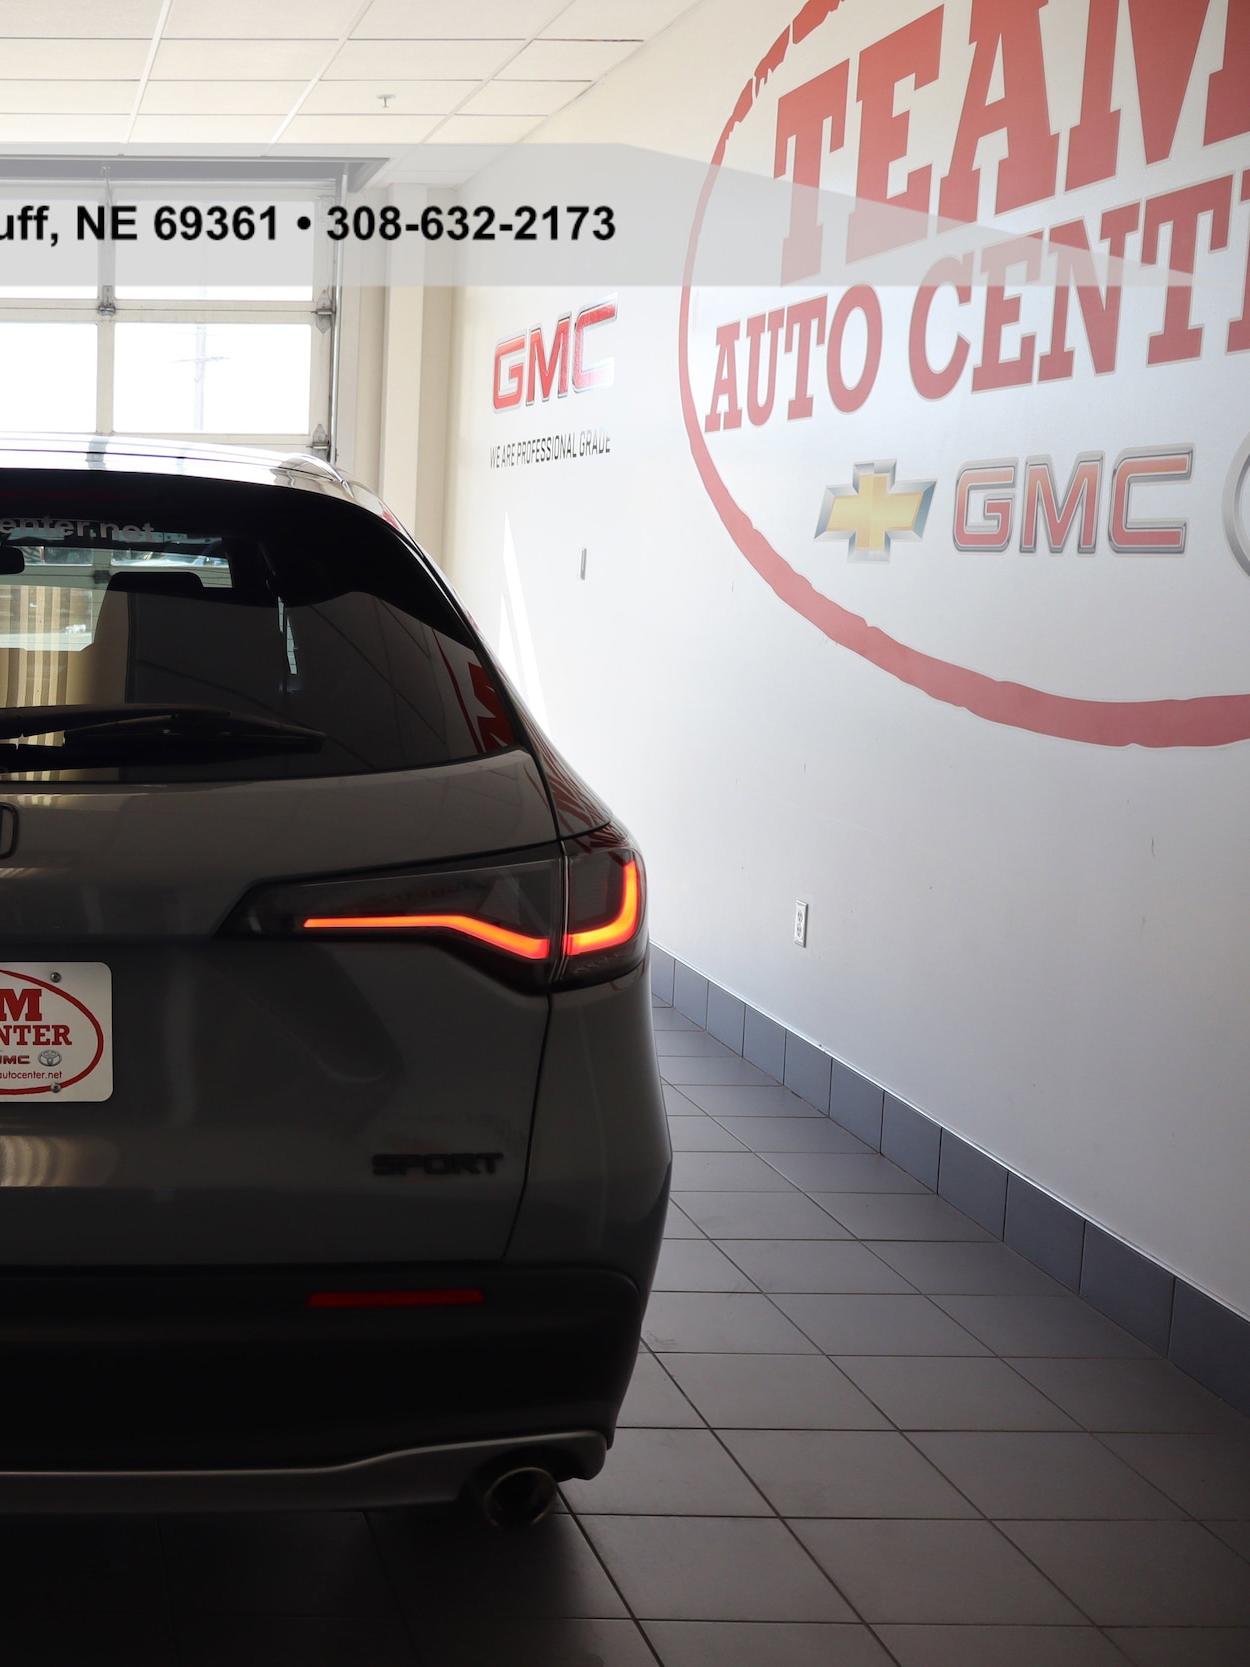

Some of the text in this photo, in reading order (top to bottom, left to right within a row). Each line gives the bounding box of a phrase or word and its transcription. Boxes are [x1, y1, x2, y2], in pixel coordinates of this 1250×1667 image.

[492, 293, 618, 414] GMC
[704, 167, 1250, 434] AUTO CENT
[490, 443, 501, 469] WE
[501, 442, 516, 468] ARE
[516, 432, 577, 466] PROFESSIONAL
[953, 442, 1195, 556] GMC
[372, 1152, 504, 1176] SPORT
